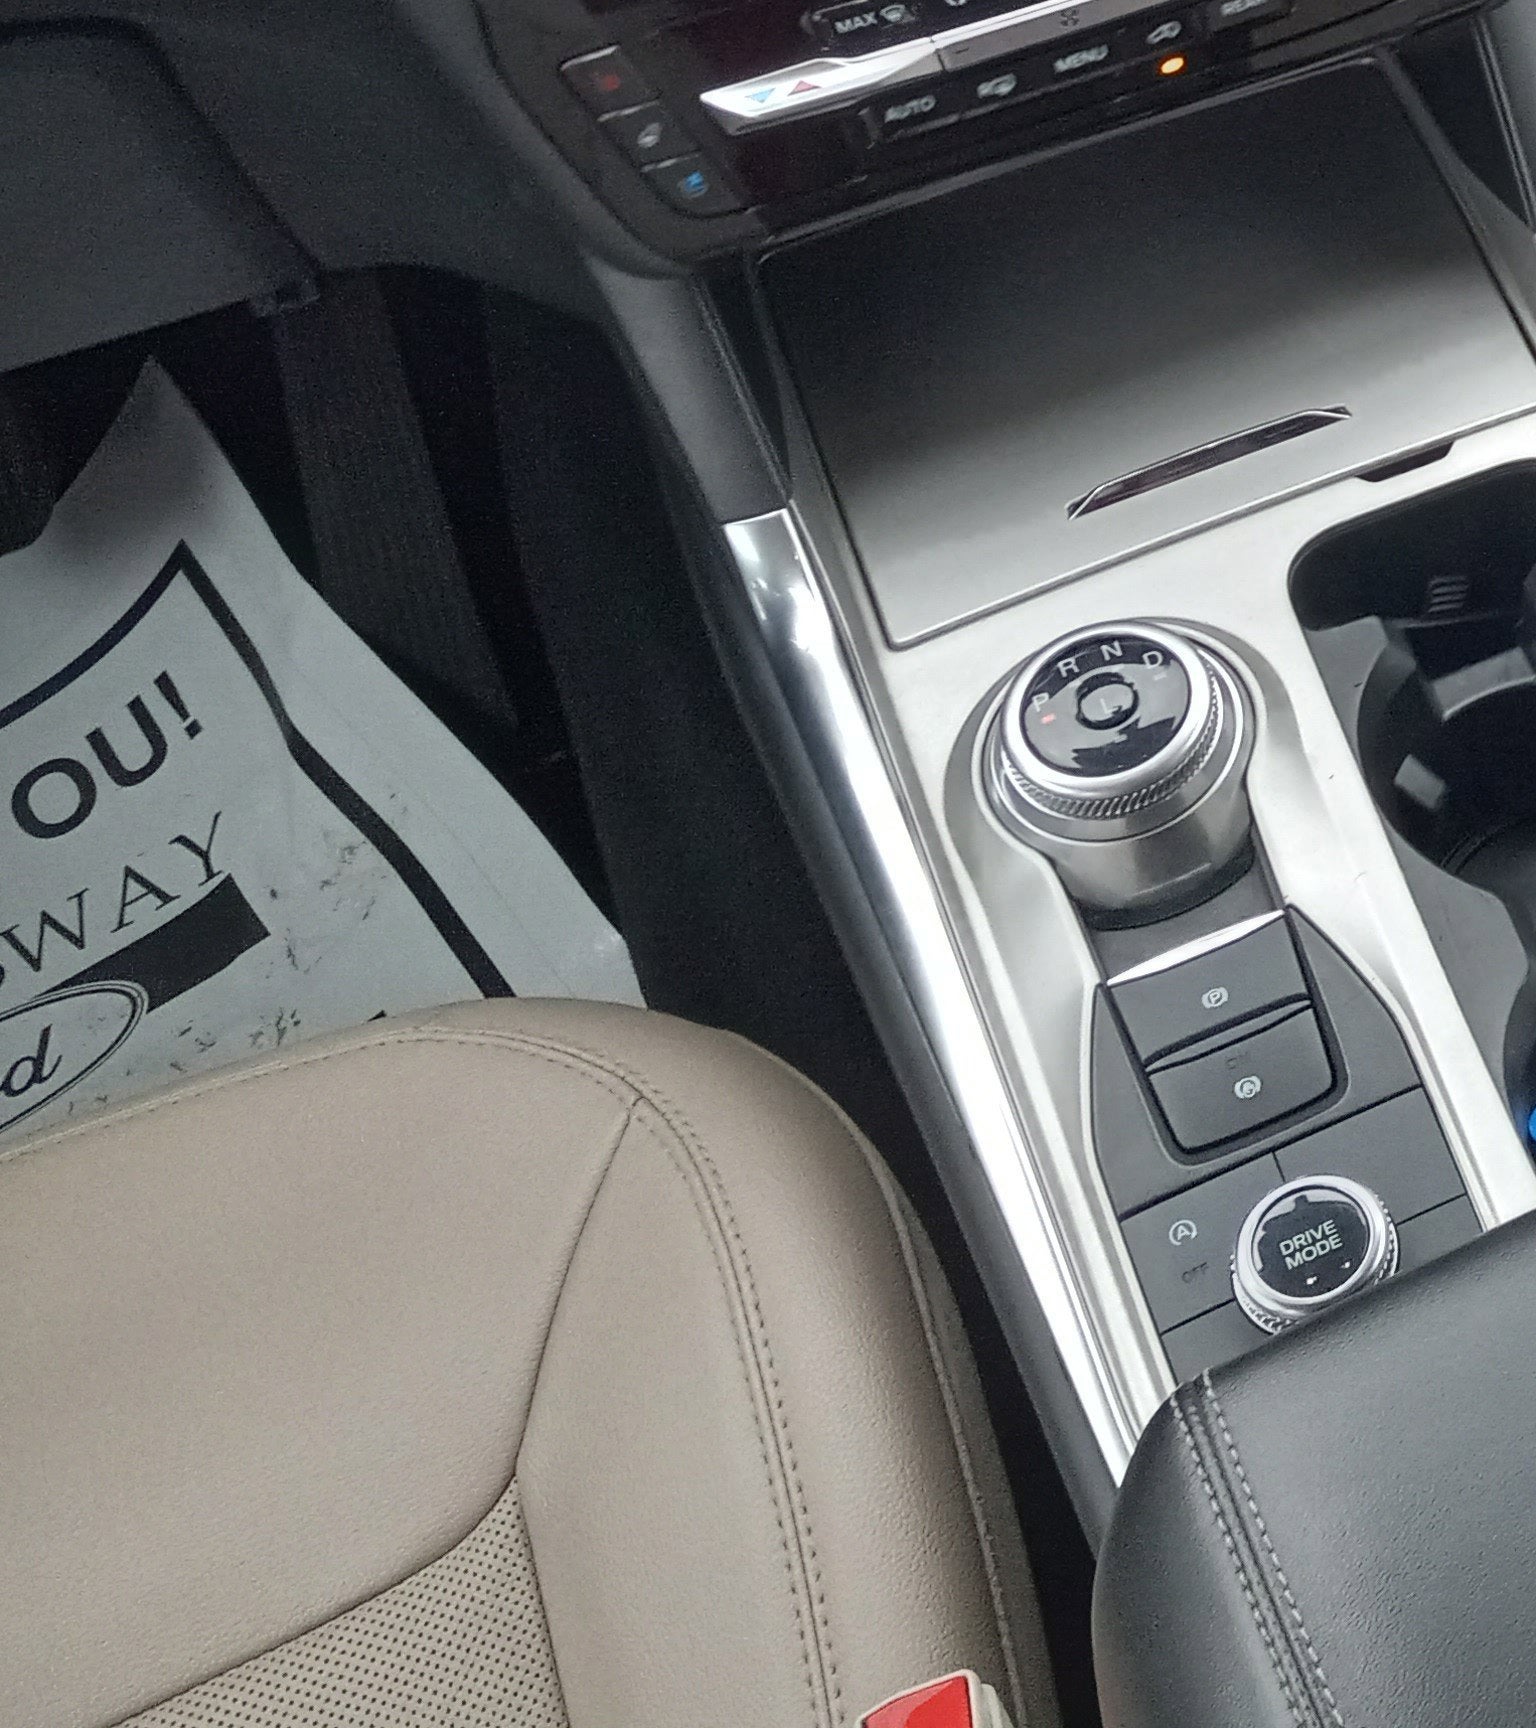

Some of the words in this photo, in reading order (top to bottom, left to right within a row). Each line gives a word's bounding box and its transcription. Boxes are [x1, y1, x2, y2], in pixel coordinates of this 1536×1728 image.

[834, 11, 878, 34] MAX
[1053, 43, 1110, 73] MENU
[885, 94, 937, 123] AUTO
[1100, 640, 1124, 662] N
[1142, 650, 1164, 670] D
[1056, 655, 1081, 678] R
[1031, 692, 1050, 713] P
[10, 670, 203, 839] OU!
[0, 810, 223, 984] WAY
[1278, 1219, 1339, 1257] DRIVE
[1284, 1233, 1344, 1271] MODE
